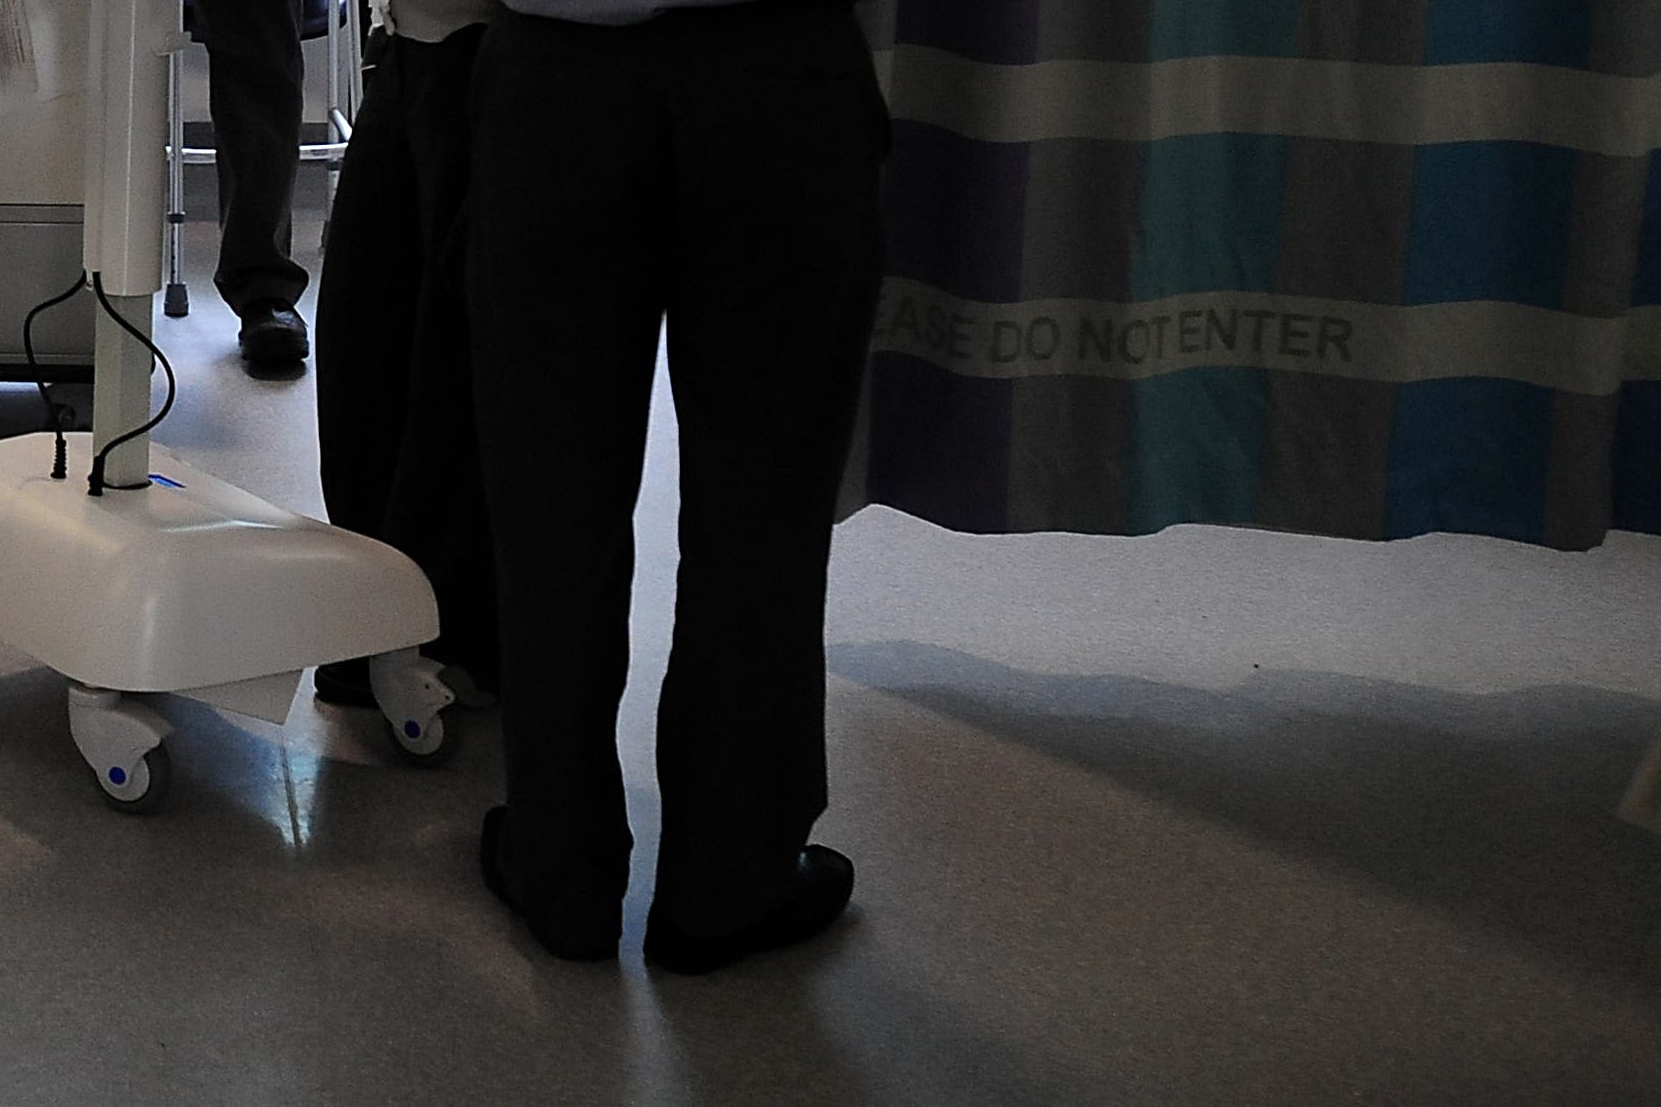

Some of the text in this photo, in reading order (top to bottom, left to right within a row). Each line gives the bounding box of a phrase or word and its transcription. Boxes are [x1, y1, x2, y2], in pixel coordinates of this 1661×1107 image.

[990, 316, 1059, 363] DO
[1076, 315, 1170, 364] NOT
[1177, 307, 1356, 362] ENTER
